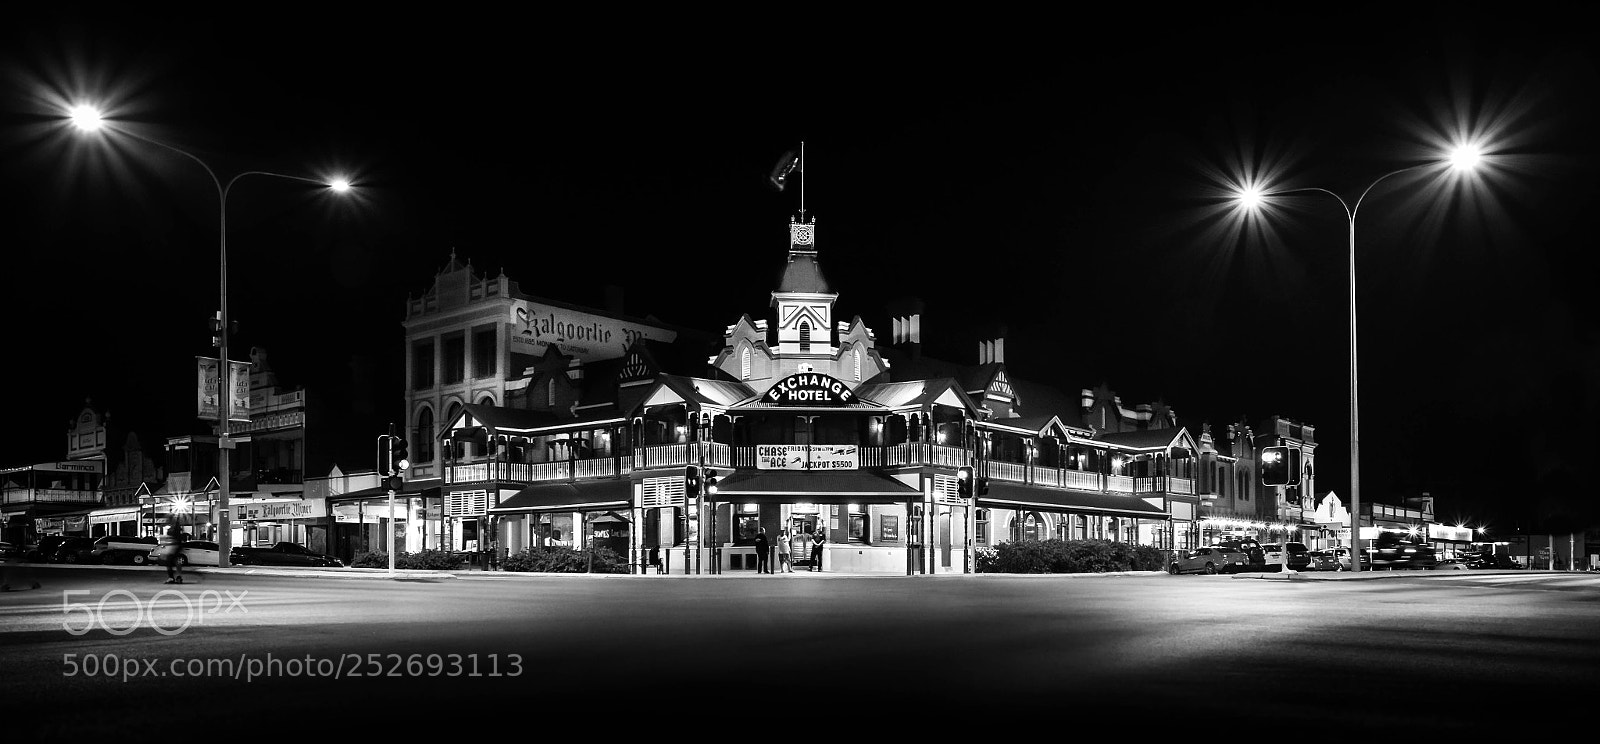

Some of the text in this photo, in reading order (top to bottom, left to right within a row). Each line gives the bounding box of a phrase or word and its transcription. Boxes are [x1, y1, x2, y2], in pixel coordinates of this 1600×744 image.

[517, 307, 612, 343] Kalgoorlie
[769, 375, 852, 402] EXCHANGE
[788, 390, 832, 401] HOTEL
[758, 446, 788, 456] CHASE
[56, 461, 95, 471] Barminco
[770, 457, 787, 468] ACE
[831, 460, 853, 468] $5500
[262, 503, 291, 518] Kalgoorlie
